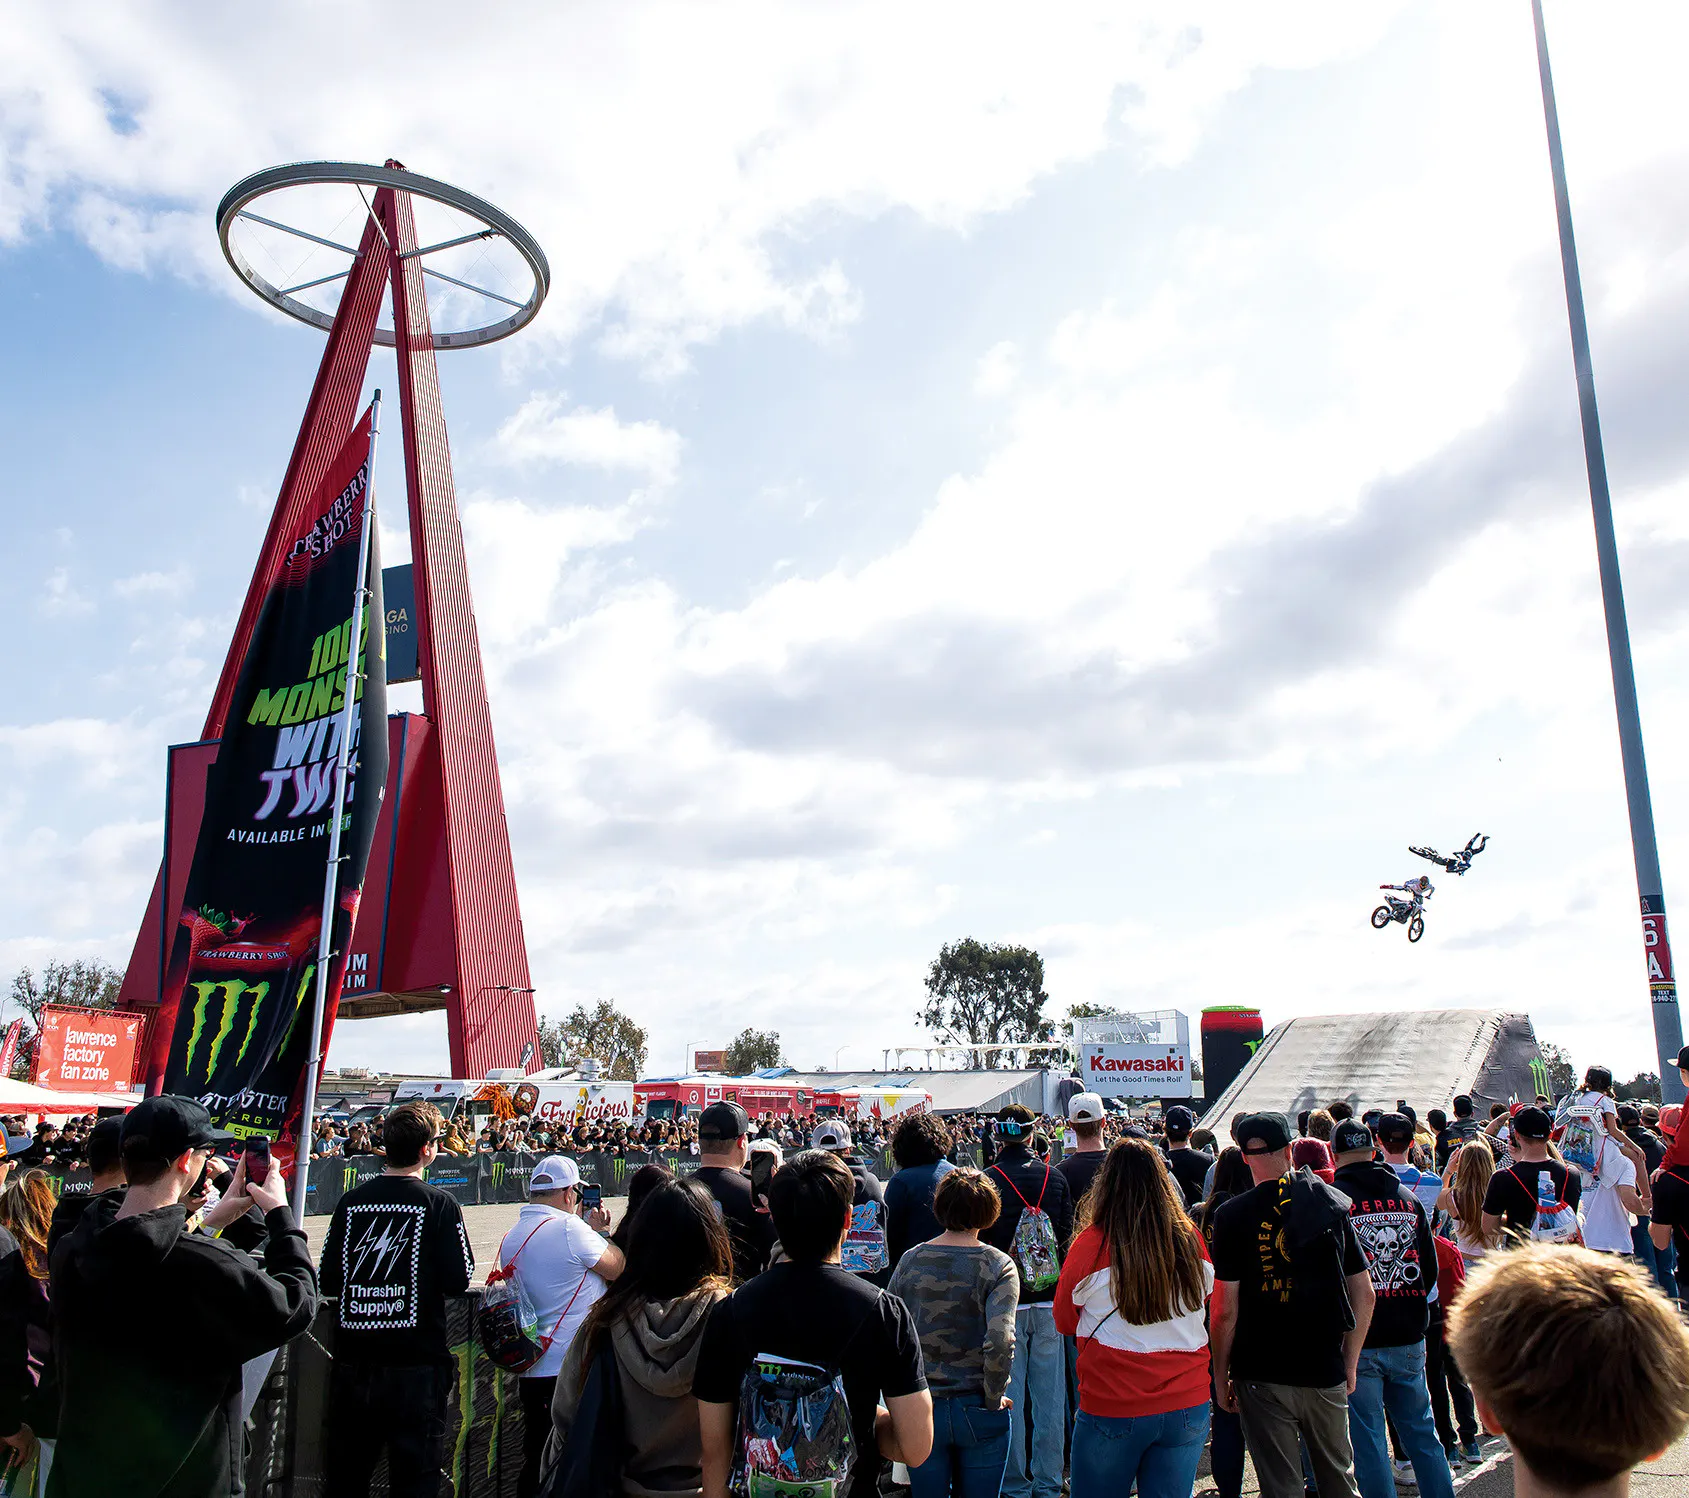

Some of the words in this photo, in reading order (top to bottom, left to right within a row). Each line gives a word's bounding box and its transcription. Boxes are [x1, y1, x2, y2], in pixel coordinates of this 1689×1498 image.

[311, 508, 353, 559] SHOT
[227, 828, 305, 844] AVAILABLE
[311, 823, 326, 838] IN
[1642, 919, 1658, 946] 6
[1649, 952, 1664, 979] A
[65, 1026, 117, 1047] lawrence
[63, 1043, 105, 1067] factory
[1090, 1055, 1184, 1071] Kawasaki
[60, 1061, 80, 1080] fan
[81, 1066, 109, 1081] zone
[1349, 1199, 1415, 1216] PERRIS
[349, 1284, 405, 1297] Thrashin
[1392, 1282, 1404, 1290] OF
